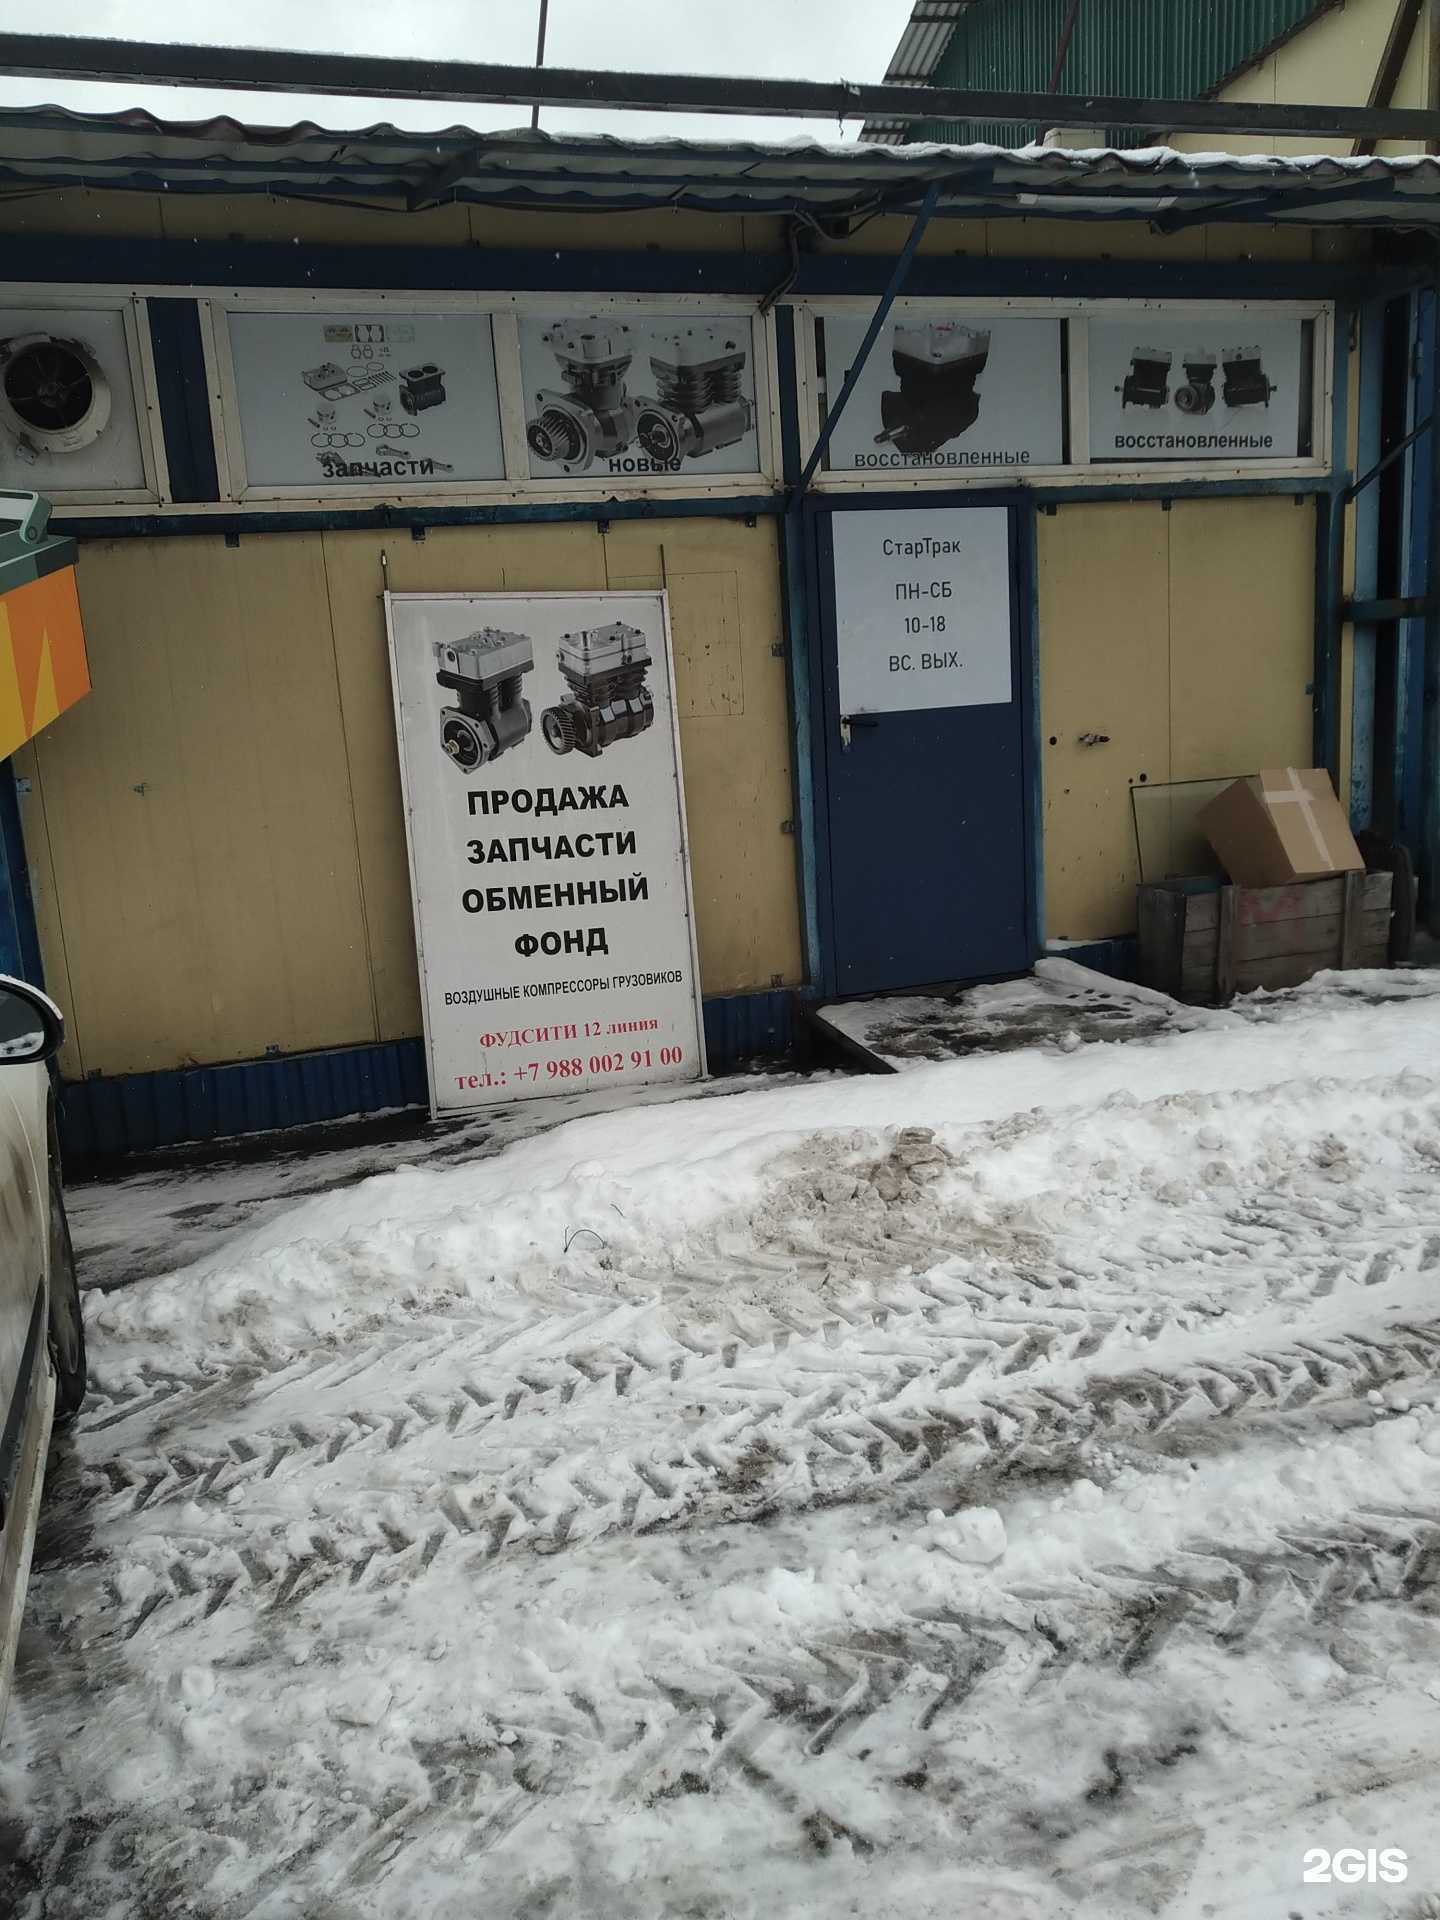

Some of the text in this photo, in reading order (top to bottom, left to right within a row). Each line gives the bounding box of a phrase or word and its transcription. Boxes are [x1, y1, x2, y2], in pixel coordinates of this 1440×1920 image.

[1114, 434, 1273, 449] восстановленные
[322, 458, 434, 478] запчасти
[608, 457, 681, 473] новые
[854, 450, 1031, 467] восстановленные
[882, 537, 961, 558] СтарТрак
[895, 581, 953, 600] ПН-СБ
[904, 615, 946, 634] 10-18
[889, 651, 964, 672] ВС. ВЫХ.
[467, 784, 629, 817] ПРОДАЖА
[466, 831, 637, 864] ЗАПЧАСТИ
[462, 871, 649, 913] ОБМЕННЫЙ
[514, 927, 609, 957] ФОНД
[444, 970, 683, 1006] ВОЗДУШНЫЕ КОМПРЕССОРЫ ГРУЗОВИКОВ
[480, 1019, 658, 1048] ФУДСИТИ 12 линия
[454, 1046, 683, 1090] тел.: +7 988 002 91 00
